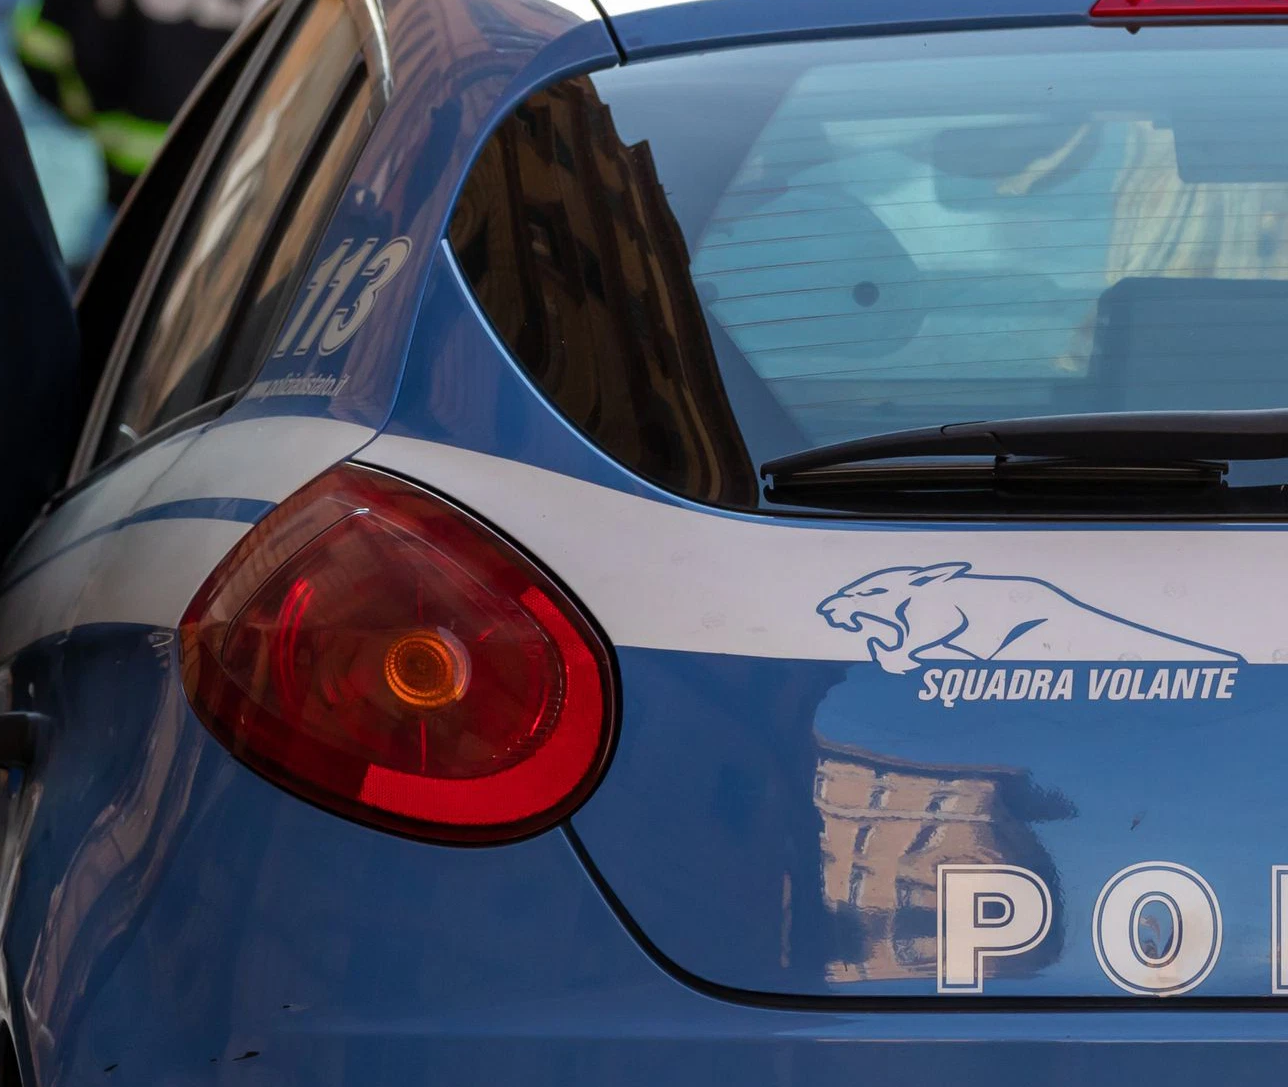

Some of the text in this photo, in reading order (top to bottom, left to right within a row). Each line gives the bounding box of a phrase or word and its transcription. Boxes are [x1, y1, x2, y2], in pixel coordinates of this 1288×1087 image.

[272, 236, 412, 358] 113
[918, 667, 1239, 707] SQUADRA VOLANTE
